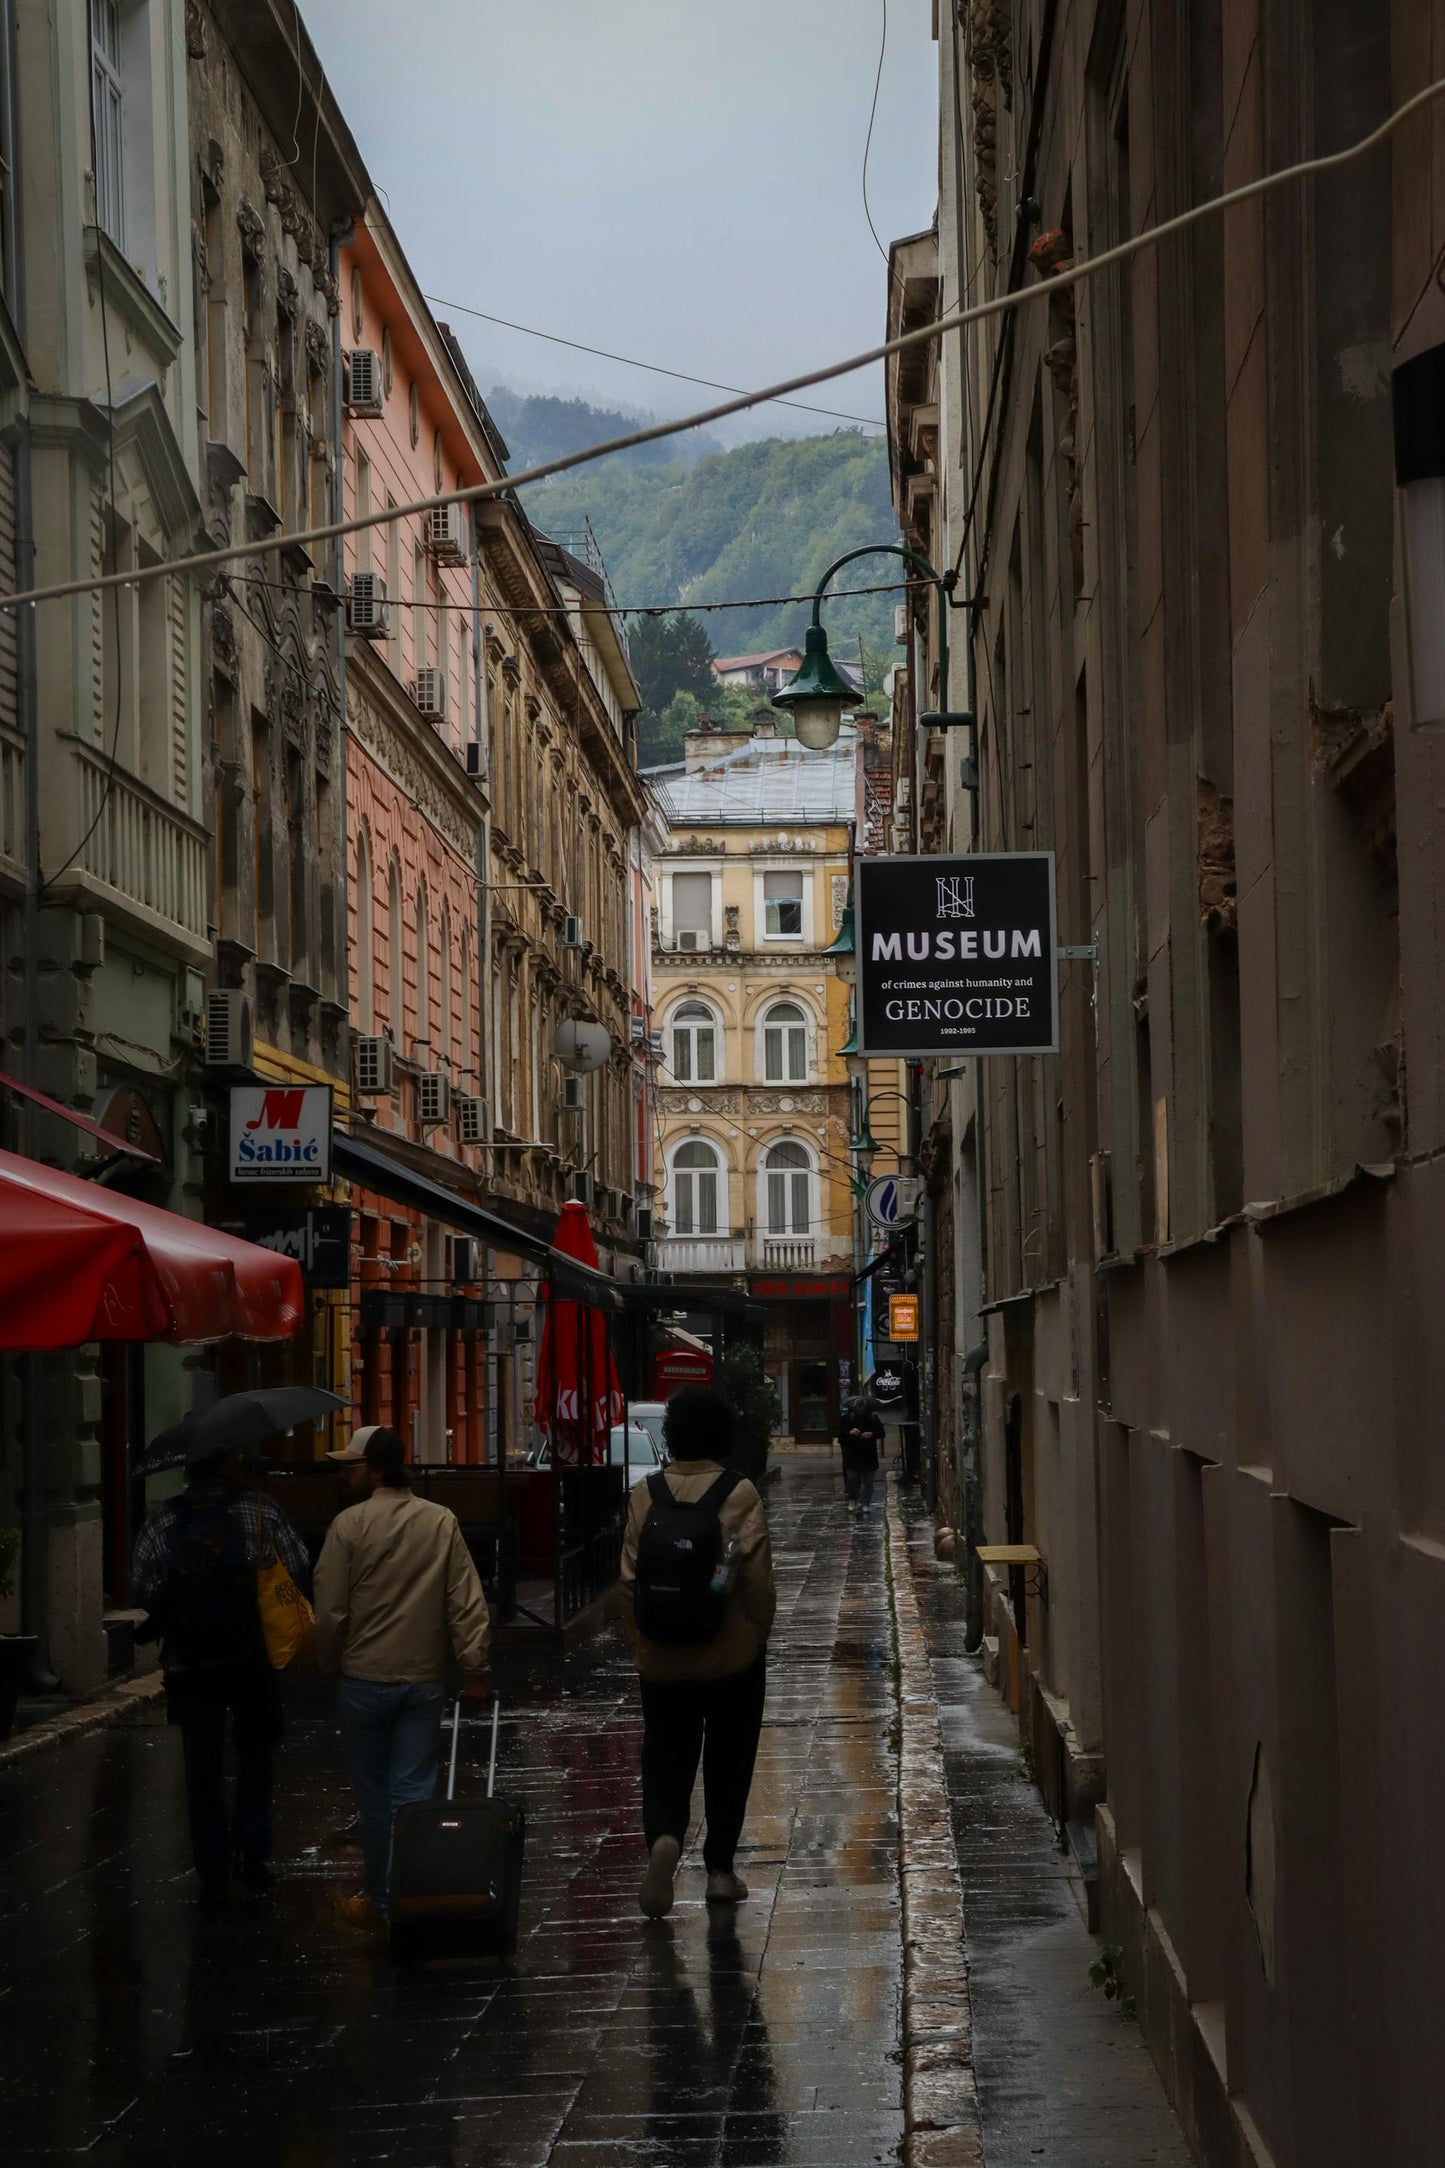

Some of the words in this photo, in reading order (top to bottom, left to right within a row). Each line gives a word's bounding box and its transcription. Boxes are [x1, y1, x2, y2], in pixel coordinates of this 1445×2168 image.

[871, 929, 1042, 962] MUSEUM
[881, 979, 892, 990] of
[893, 979, 927, 989] crimes
[928, 978, 964, 991] against
[966, 977, 1013, 990] humanity
[1014, 977, 1033, 987] and
[885, 998, 1031, 1021] GENOCIDE
[940, 1027, 976, 1035] 1992-1995
[239, 1132, 318, 1161] Šabić
